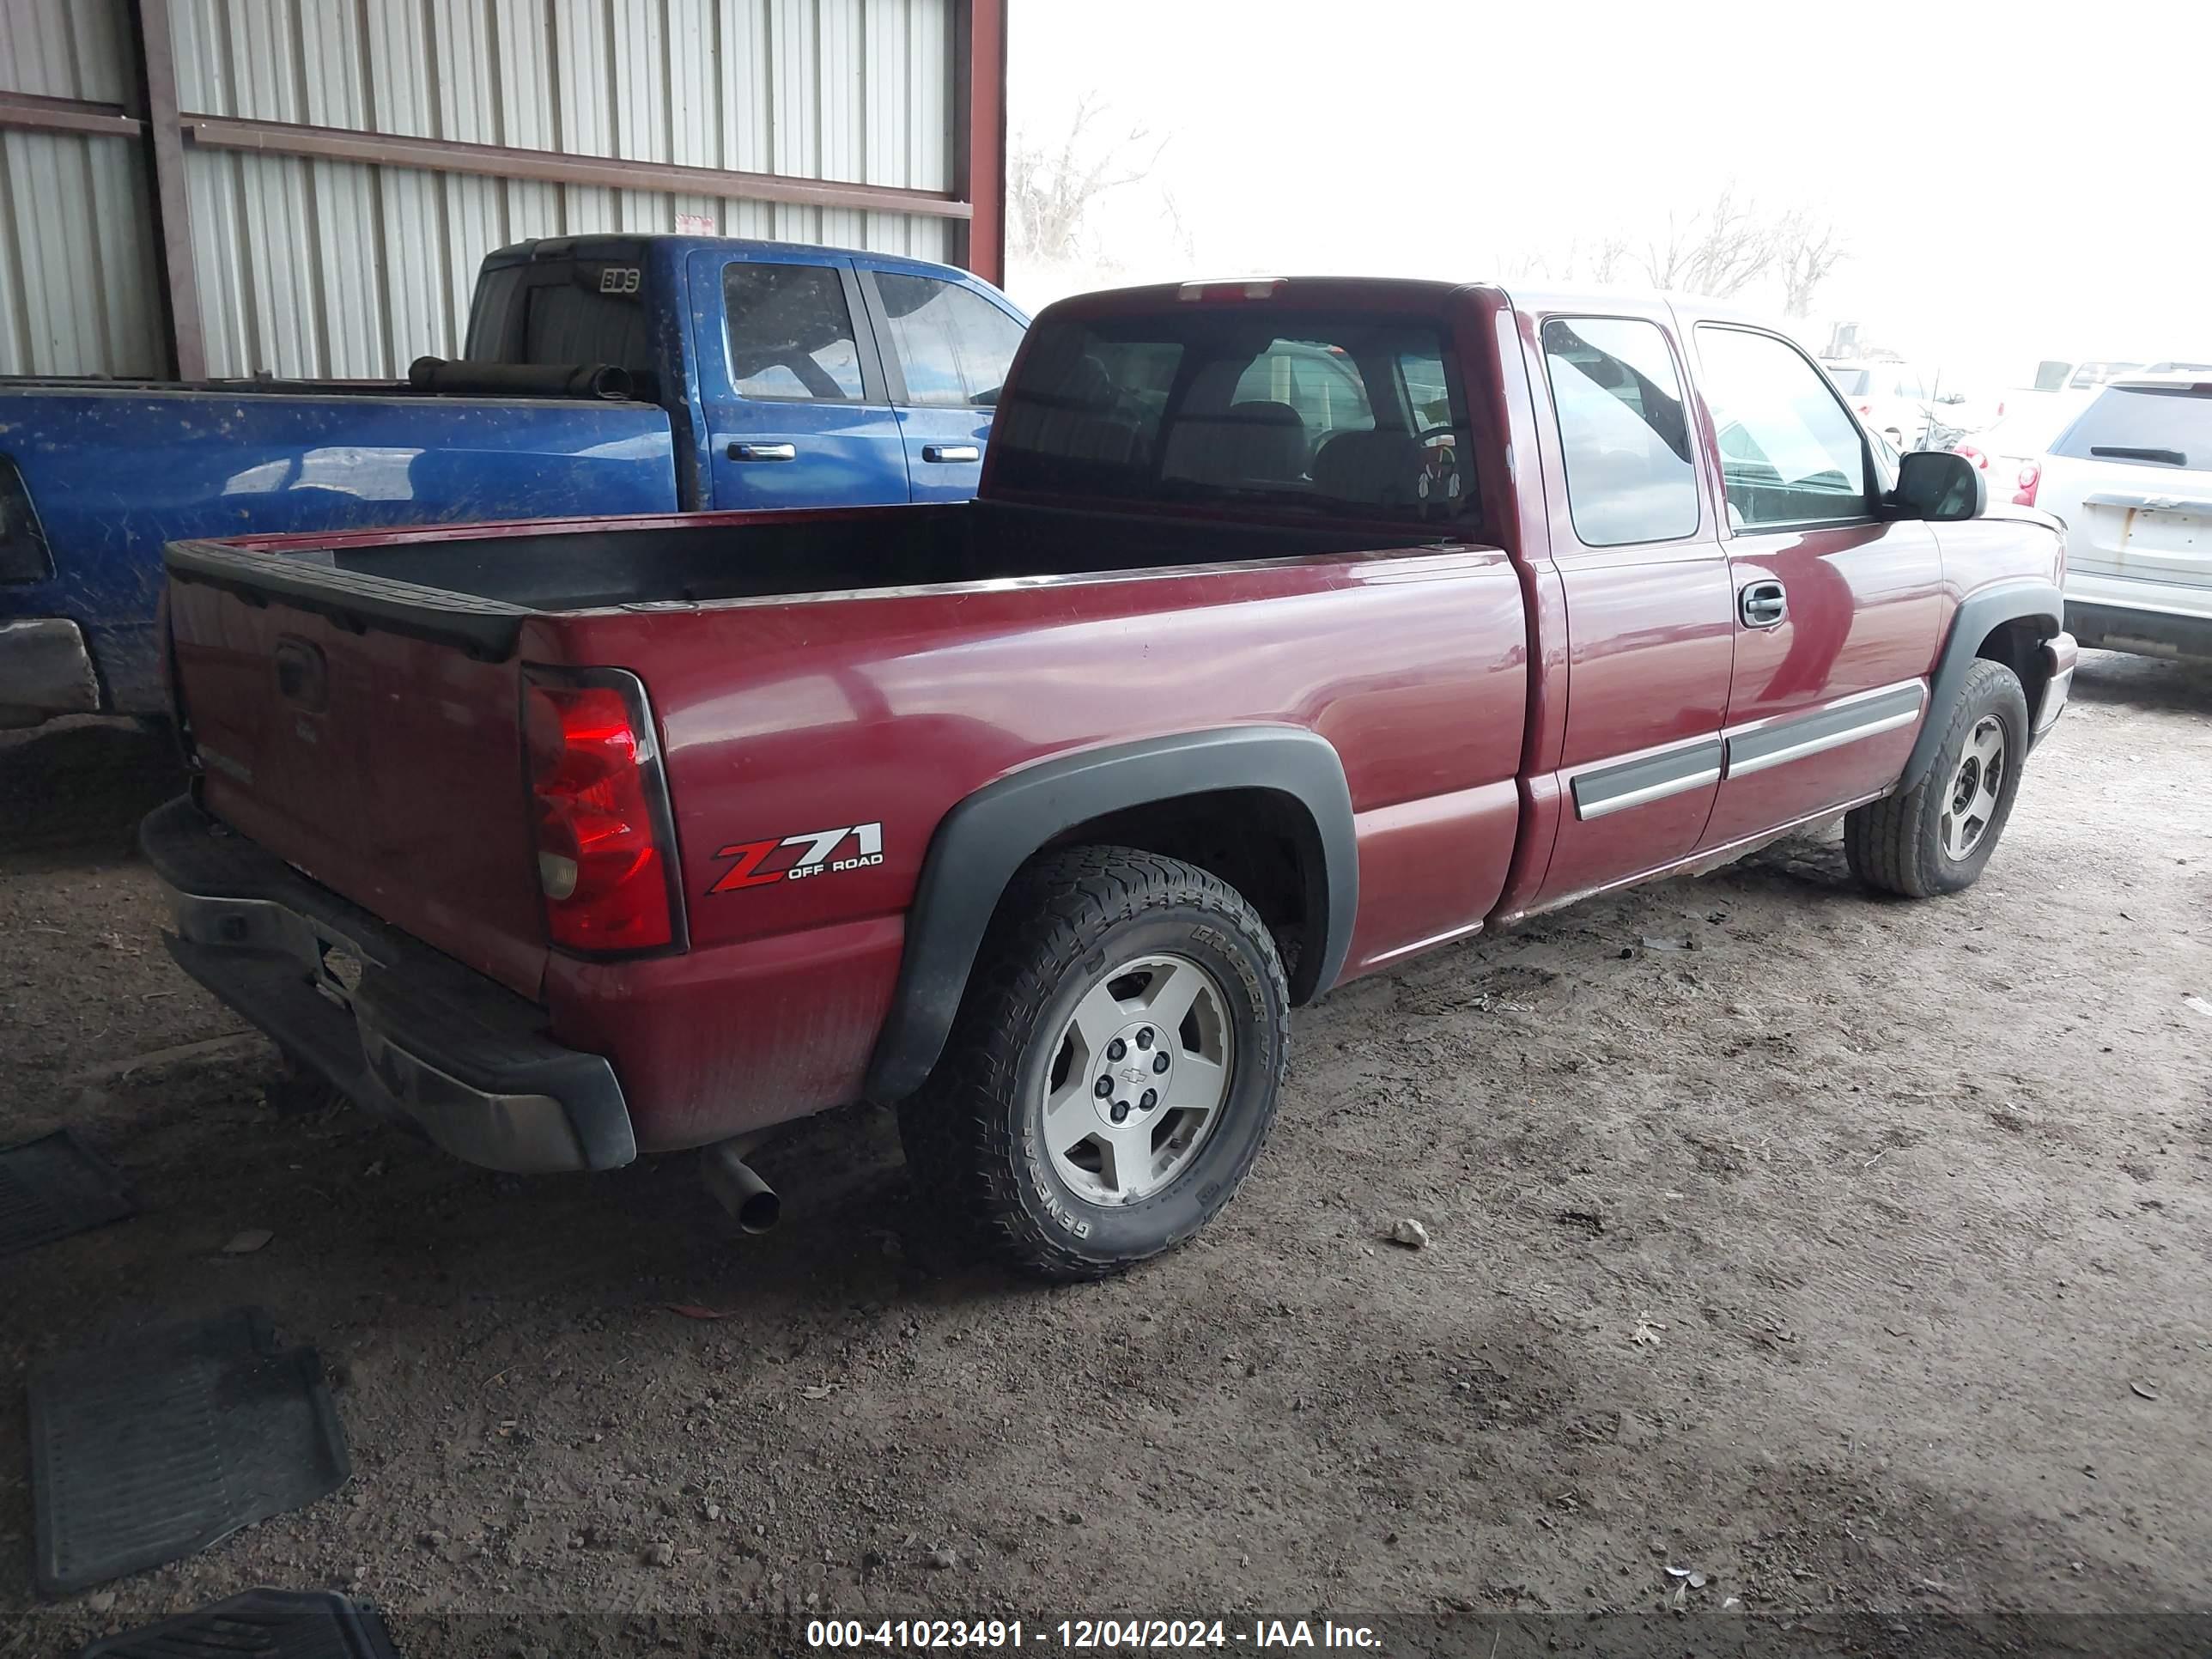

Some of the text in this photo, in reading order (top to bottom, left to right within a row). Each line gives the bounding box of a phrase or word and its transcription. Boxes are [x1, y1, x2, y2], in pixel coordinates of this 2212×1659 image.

[707, 822, 882, 894] Z71
[788, 854, 884, 879] OFF ROAD
[1191, 925, 1268, 1023] GRABBER
[1023, 1115, 1091, 1240] GENERAL
